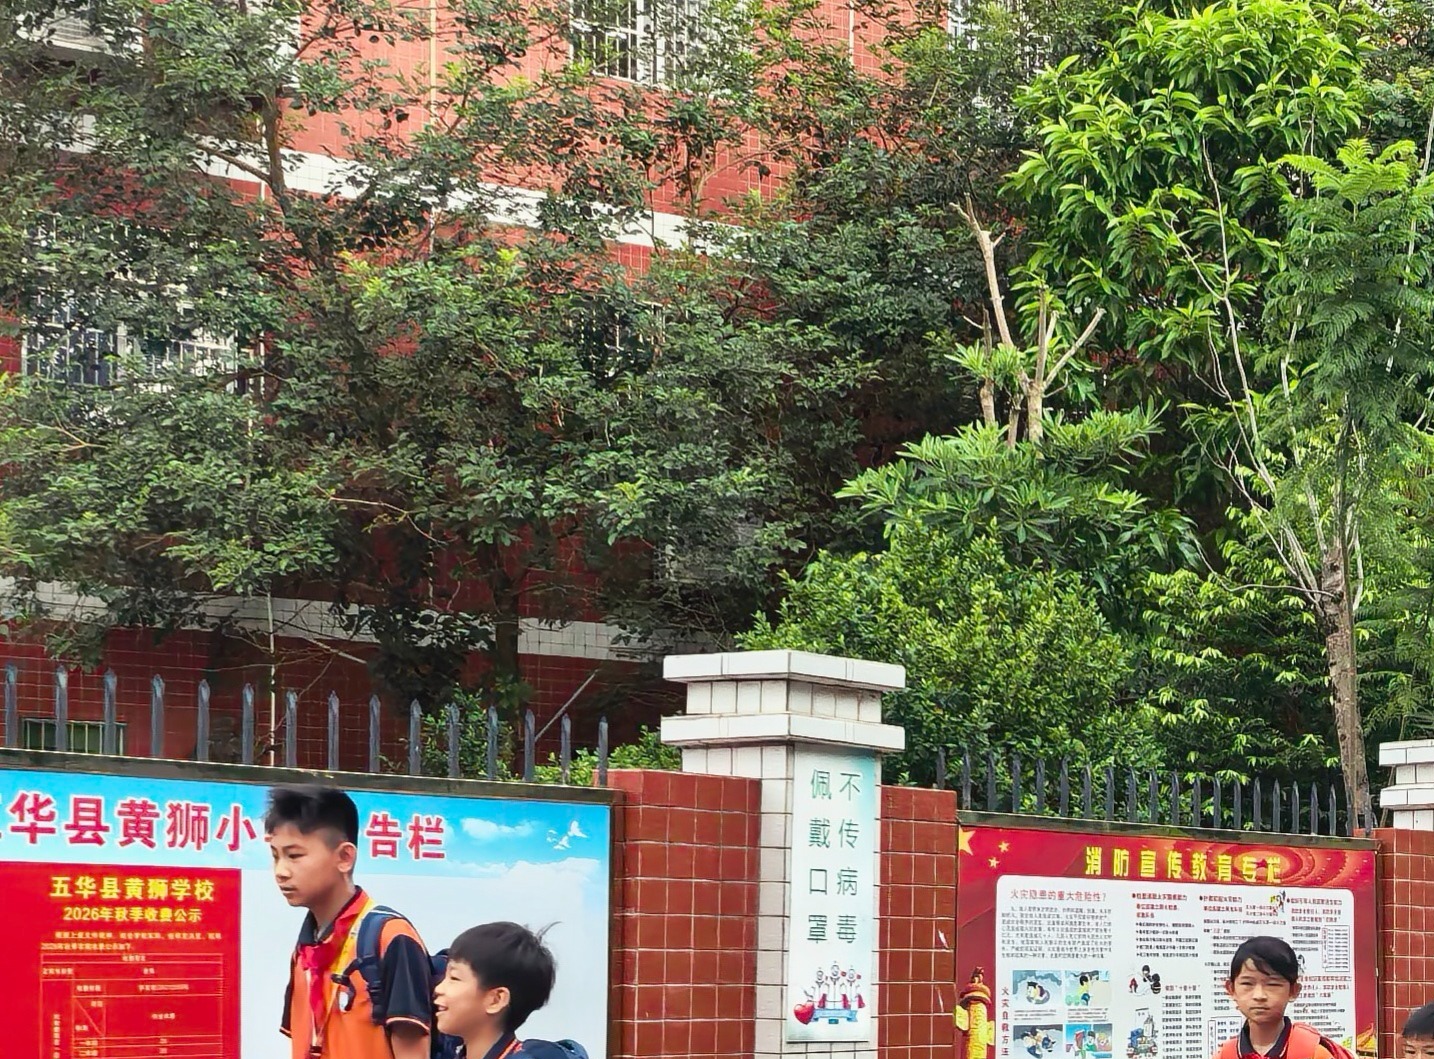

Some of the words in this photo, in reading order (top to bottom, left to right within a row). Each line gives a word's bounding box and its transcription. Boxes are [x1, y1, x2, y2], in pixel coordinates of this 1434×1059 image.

[50, 876, 215, 901] 五华县黄狮学校
[807, 769, 832, 944] 佩戴口罩
[836, 772, 861, 943] 不传病毒
[1085, 846, 1281, 884] 消防宣传教育专栏
